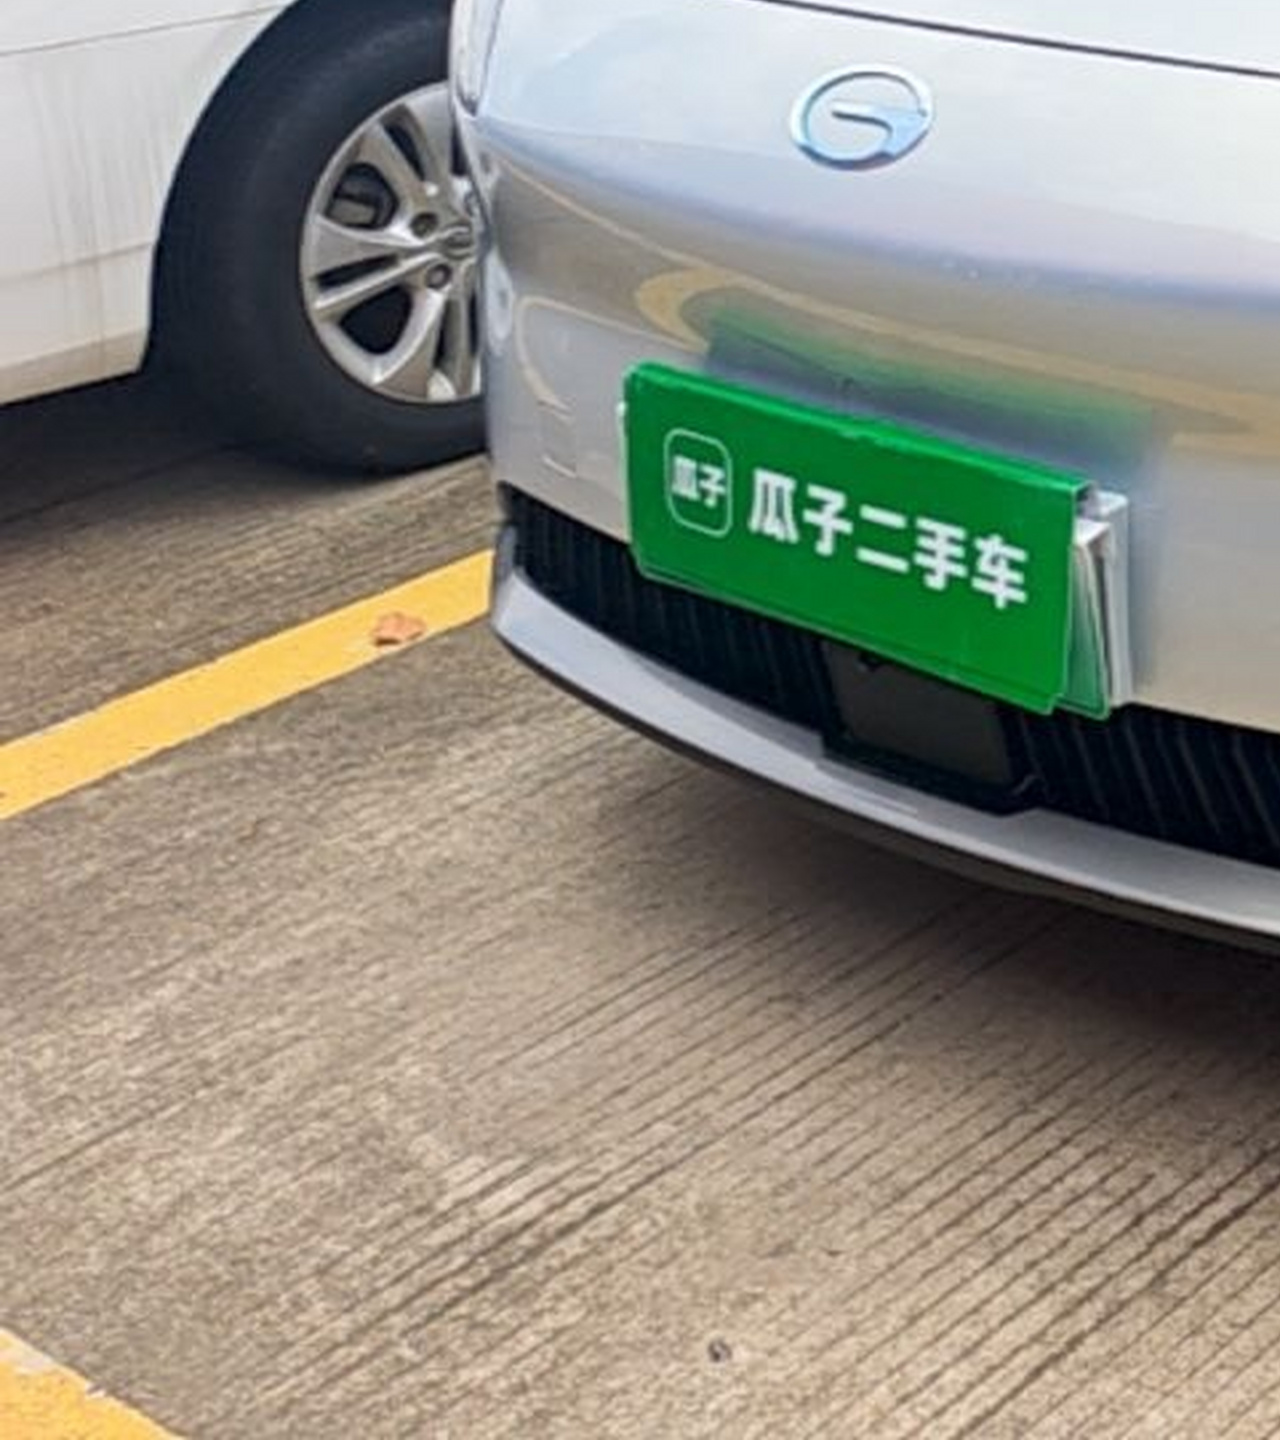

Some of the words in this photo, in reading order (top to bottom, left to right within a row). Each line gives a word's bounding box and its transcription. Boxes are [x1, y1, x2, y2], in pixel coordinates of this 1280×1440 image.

[671, 455, 727, 508] 瓜子
[748, 467, 1029, 610] 瓜子二手车
